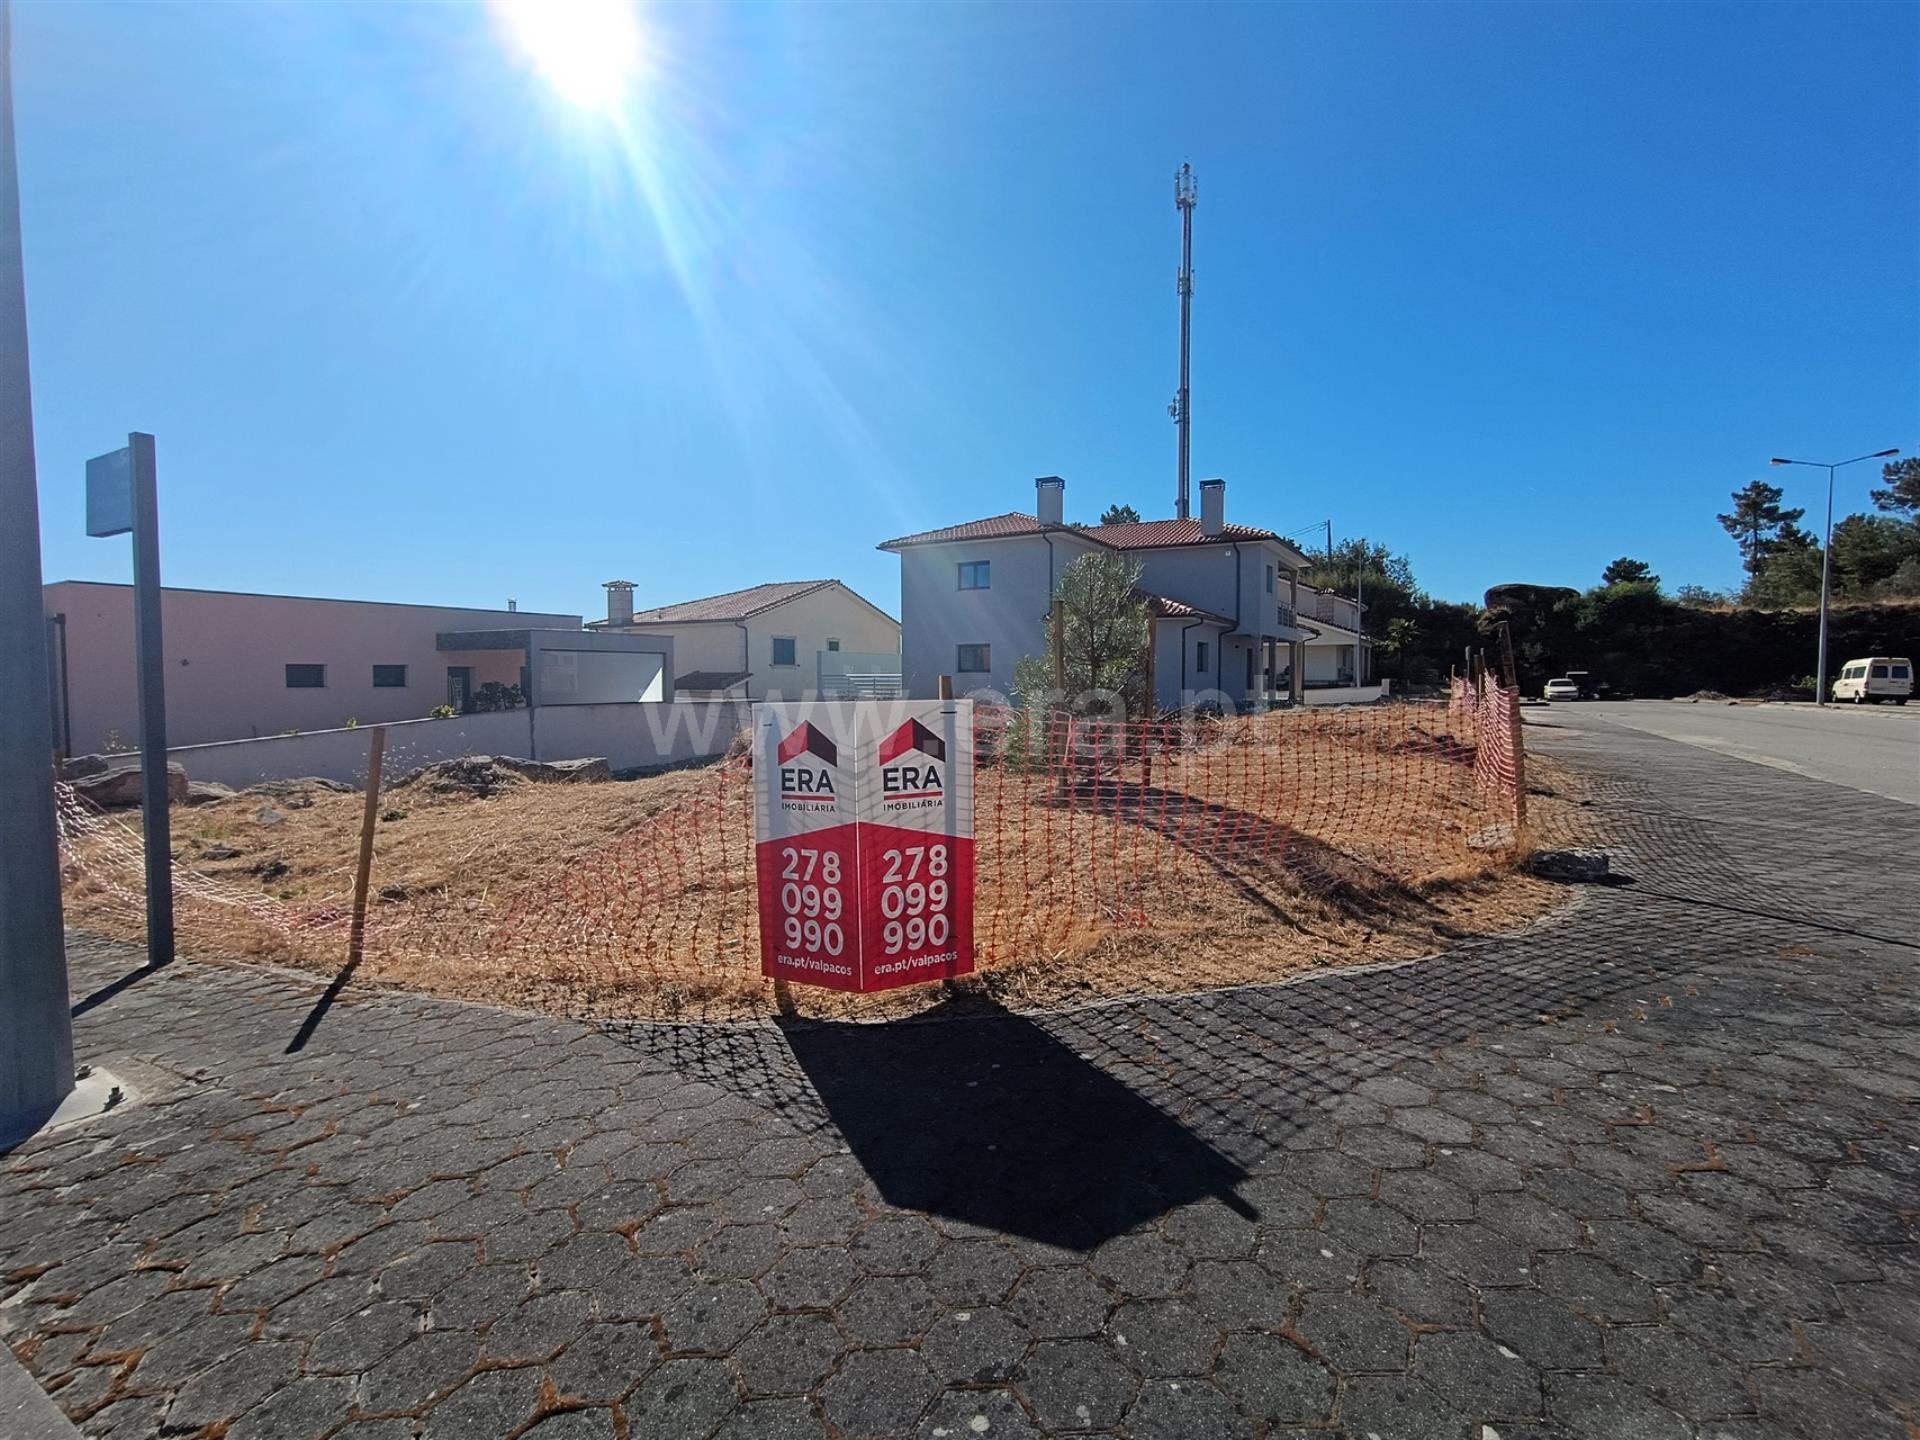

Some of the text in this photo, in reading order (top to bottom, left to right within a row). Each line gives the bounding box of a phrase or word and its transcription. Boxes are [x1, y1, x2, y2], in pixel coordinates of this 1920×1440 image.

[781, 768, 835, 793] ERA
[883, 765, 942, 792] ERA
[782, 802, 836, 812] IMOBILIÁRIA
[883, 800, 943, 811] IMOBILIÁRIA
[782, 847, 841, 884] 278
[883, 844, 948, 884] 278
[782, 882, 842, 919] 099
[881, 879, 948, 919] 099
[784, 917, 844, 956] 990
[884, 913, 949, 954] 990
[777, 954, 853, 976] era.pt/valpacos
[874, 951, 958, 975] era.pt/valpacos
